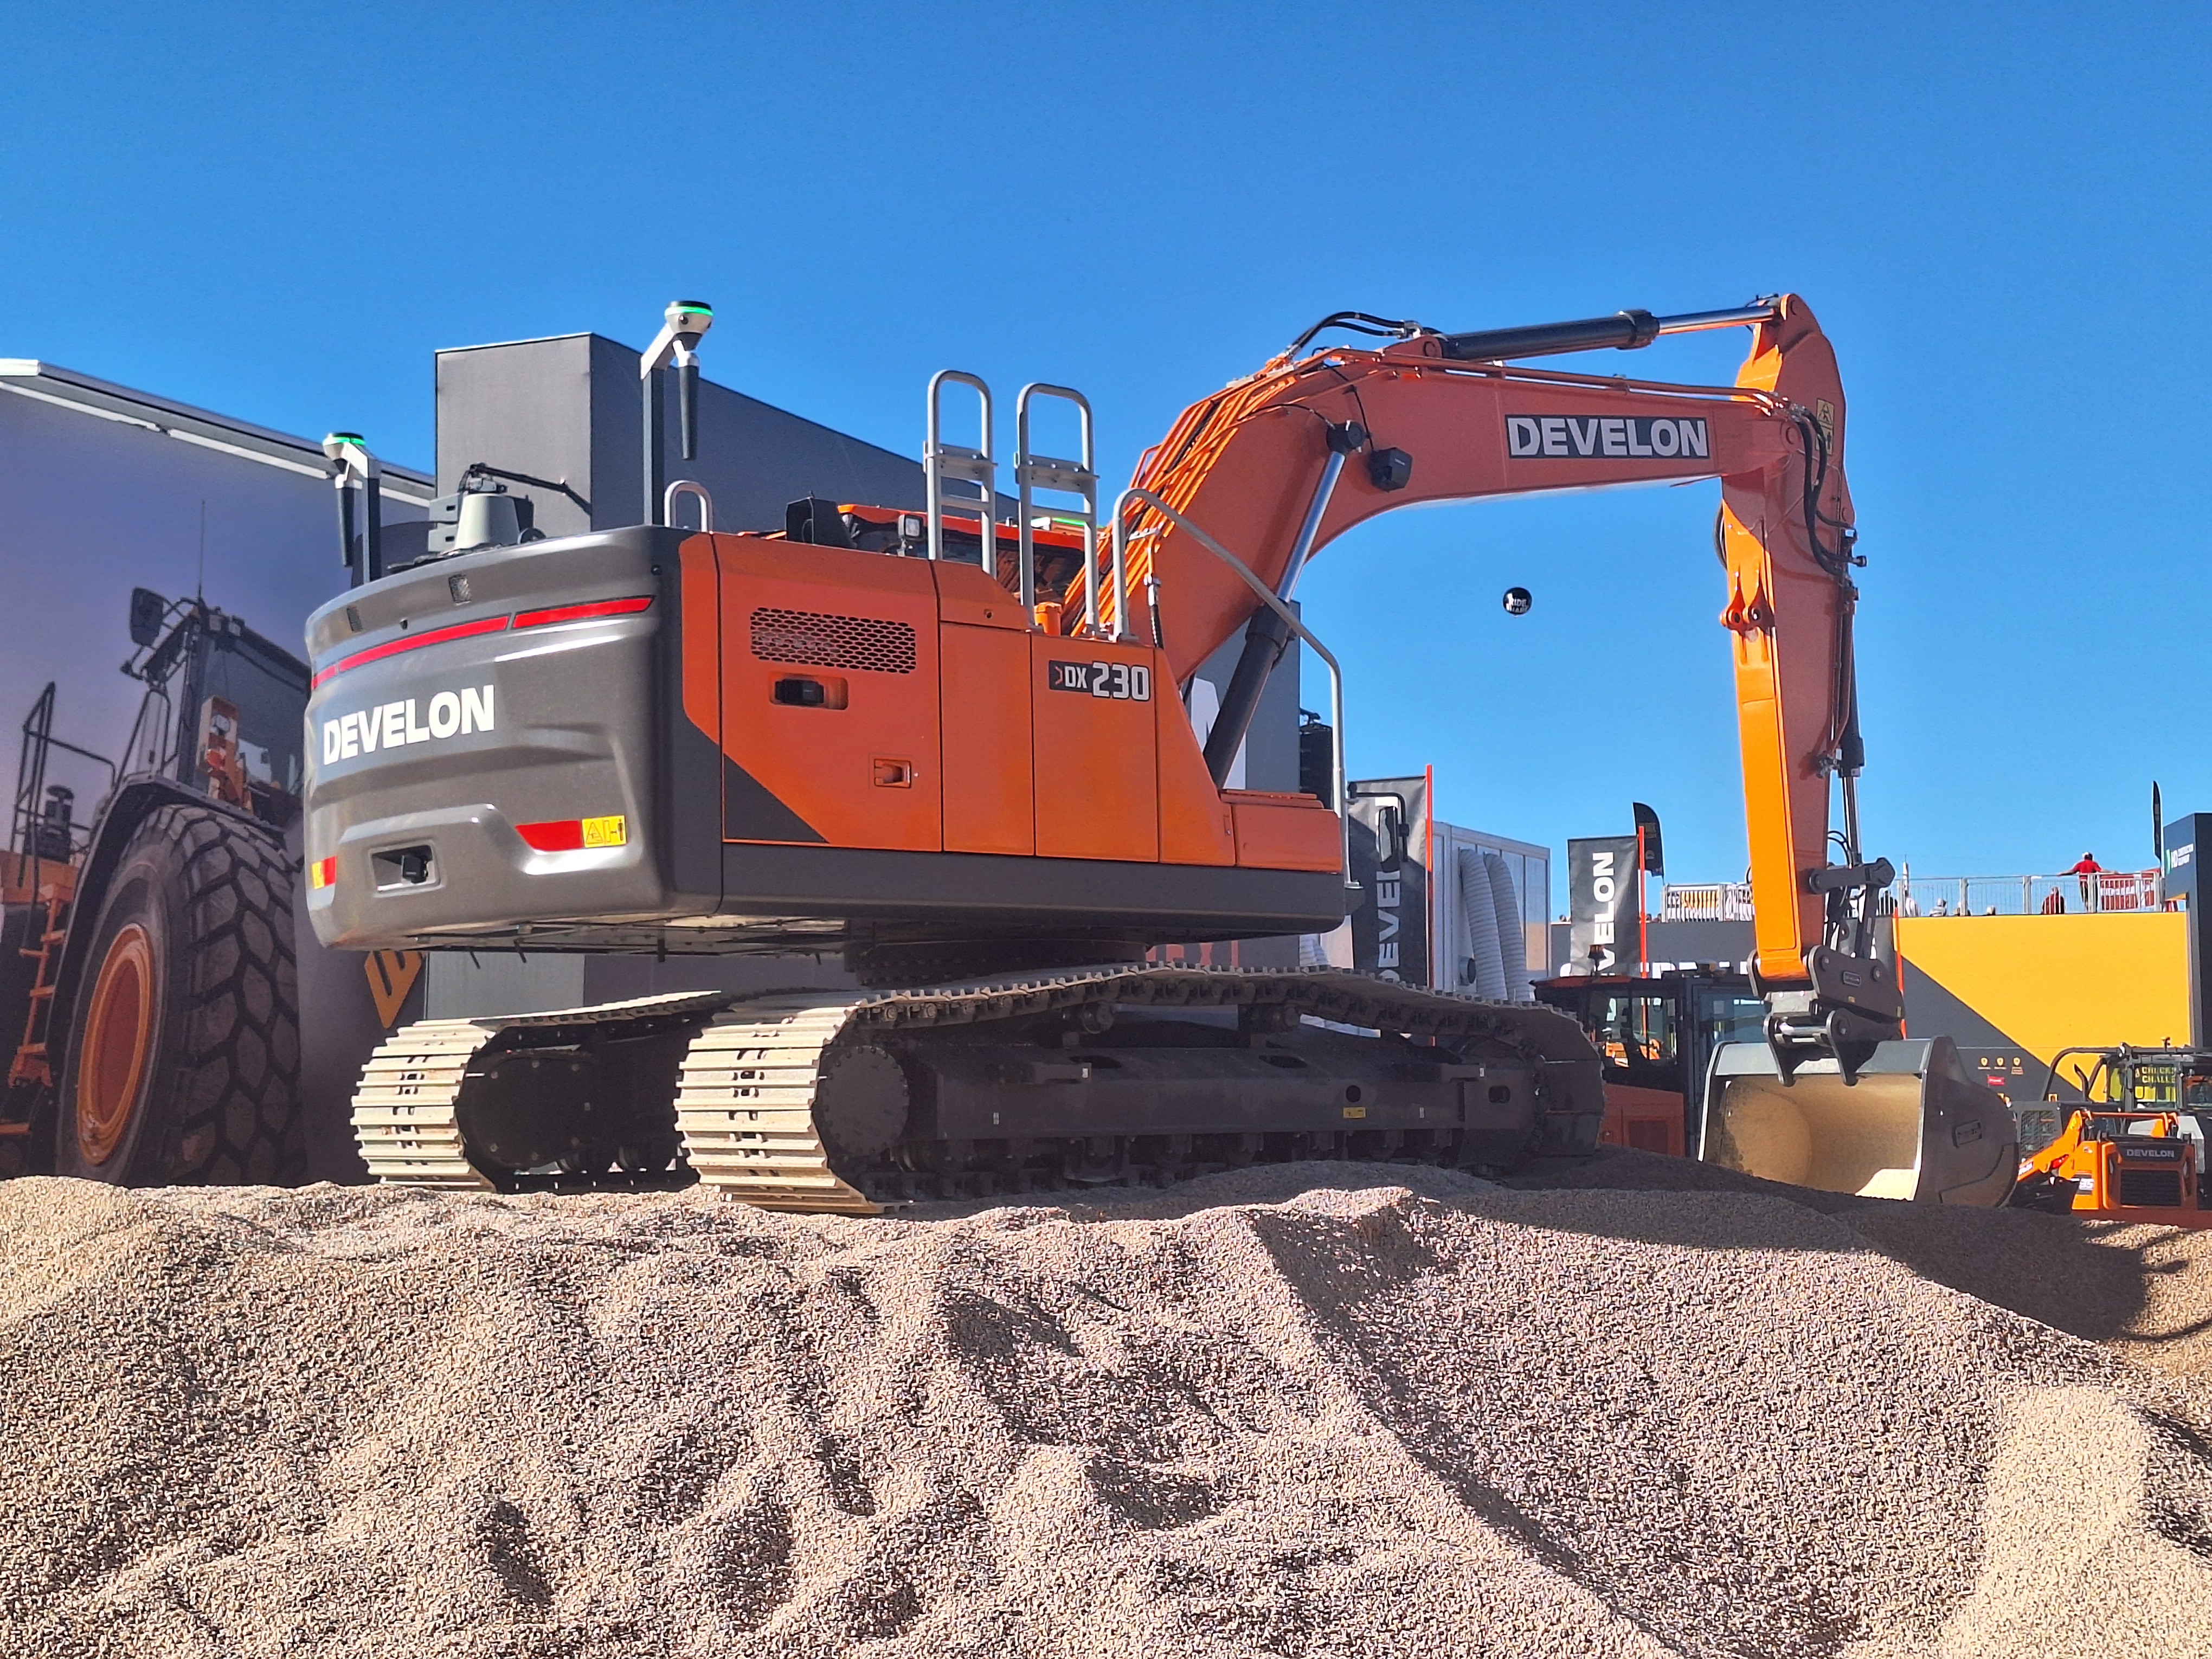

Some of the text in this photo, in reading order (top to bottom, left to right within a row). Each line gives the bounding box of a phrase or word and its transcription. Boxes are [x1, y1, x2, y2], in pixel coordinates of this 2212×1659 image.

[1507, 417, 1708, 456] DEVELON
[1064, 661, 1150, 700] DX 230
[324, 684, 494, 766] DEVELON
[2126, 1149, 2175, 1158] DEVELON
